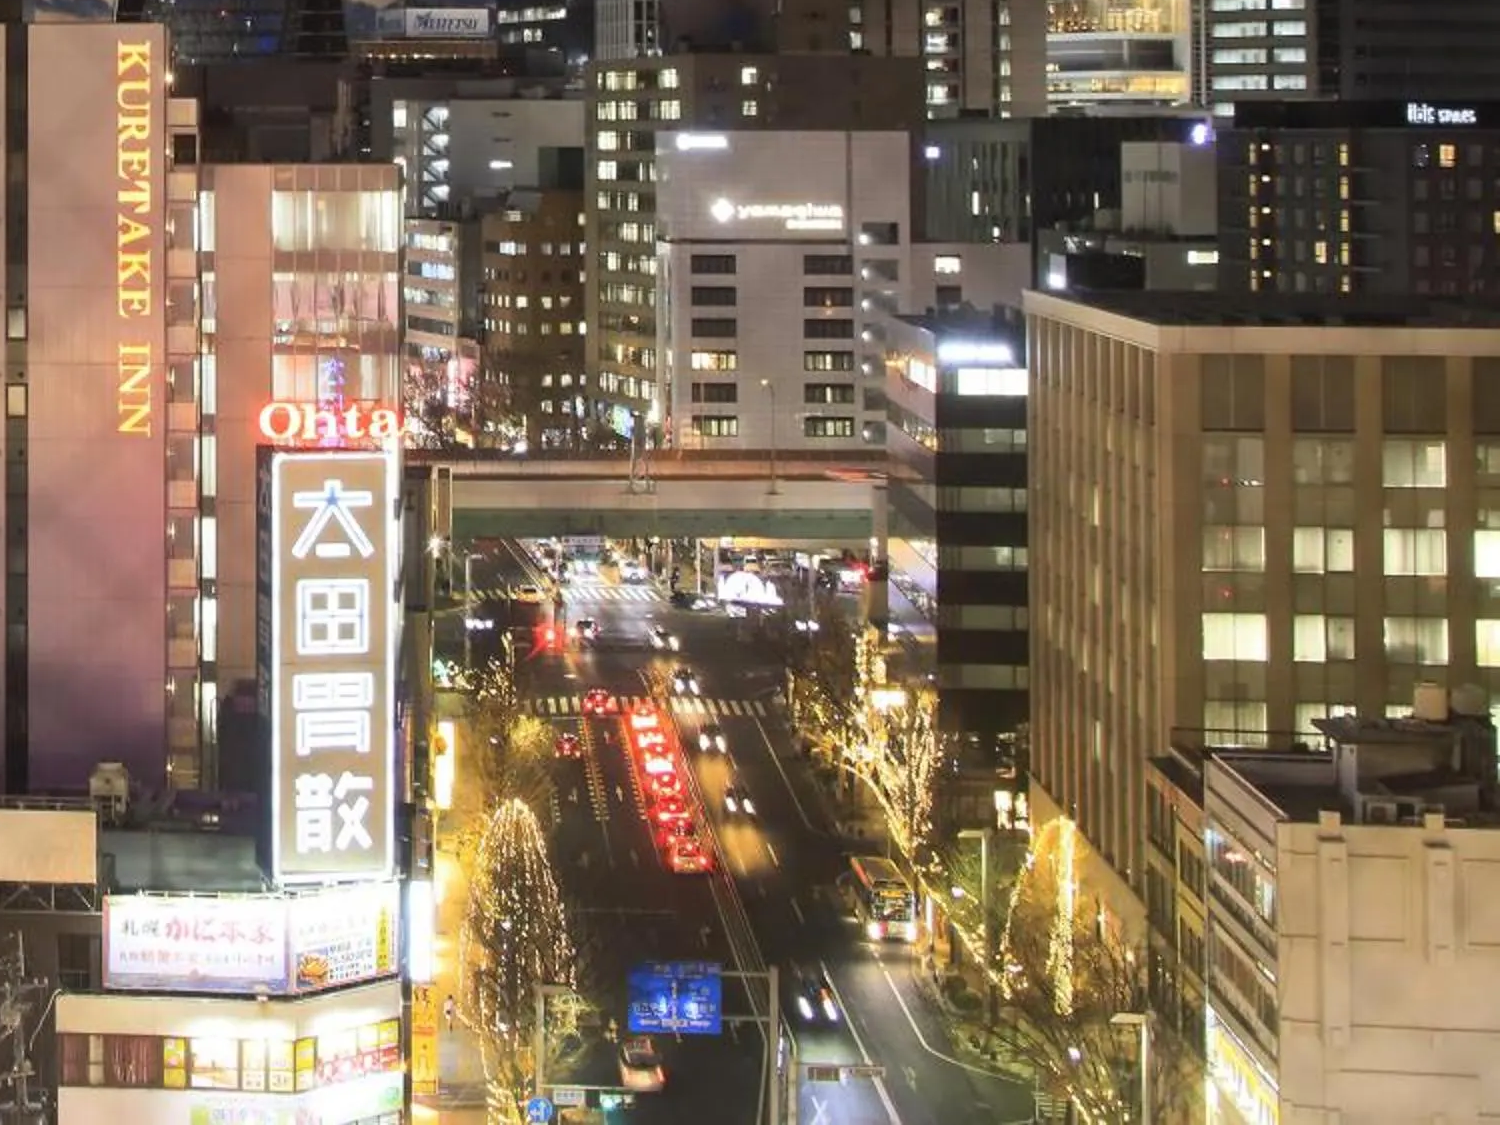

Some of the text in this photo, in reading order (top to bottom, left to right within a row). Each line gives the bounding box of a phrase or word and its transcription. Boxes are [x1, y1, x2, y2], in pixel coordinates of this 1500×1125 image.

[117, 40, 152, 438] KURETAKE INN
[259, 401, 405, 442] Ohta
[291, 478, 376, 854] 太田胃散
